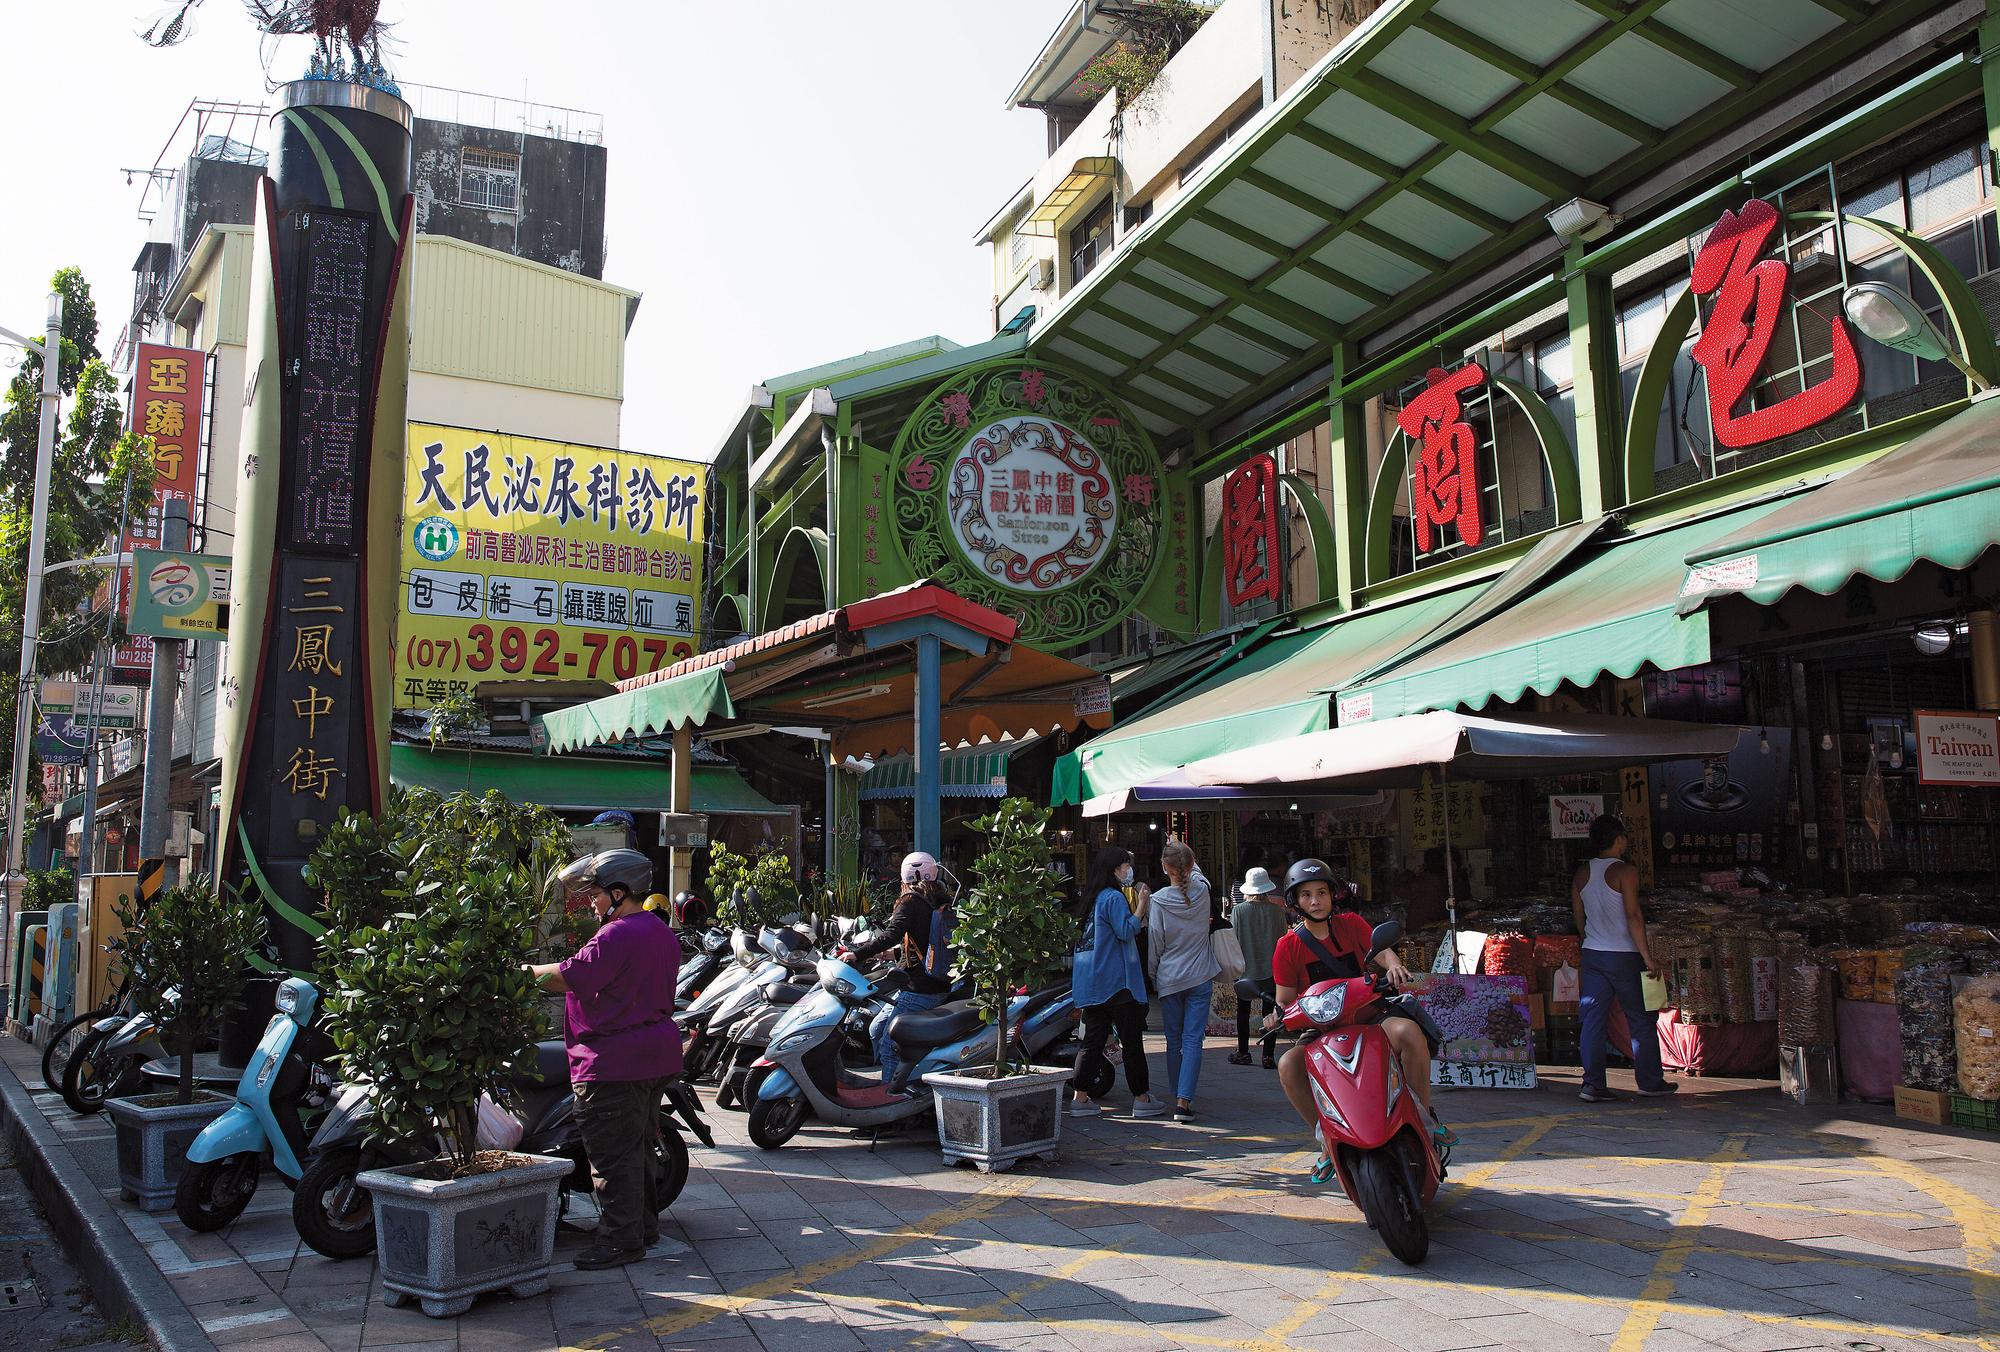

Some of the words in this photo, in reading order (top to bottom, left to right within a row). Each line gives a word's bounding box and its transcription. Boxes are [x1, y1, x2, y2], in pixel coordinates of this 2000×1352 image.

[416, 442, 700, 544] 天民泌尿科診所
[989, 468, 1075, 494] 三鳳中街
[989, 490, 1075, 517] 觀光商圈
[1011, 529, 1049, 545] Stree
[464, 528, 693, 583] 前高醫泌尿科主治醫師聯合診治
[213, 569, 233, 591] 三
[412, 575, 479, 613] 包皮
[489, 580, 553, 617] 結石
[634, 594, 692, 632] 疝氣
[180, 618, 214, 629] 剩餘空位
[280, 576, 344, 801] 三鳳中街
[404, 678, 478, 704] 平等路
[1927, 736, 1994, 757] Taiwan
[1430, 1061, 1530, 1087] 益商行24號
